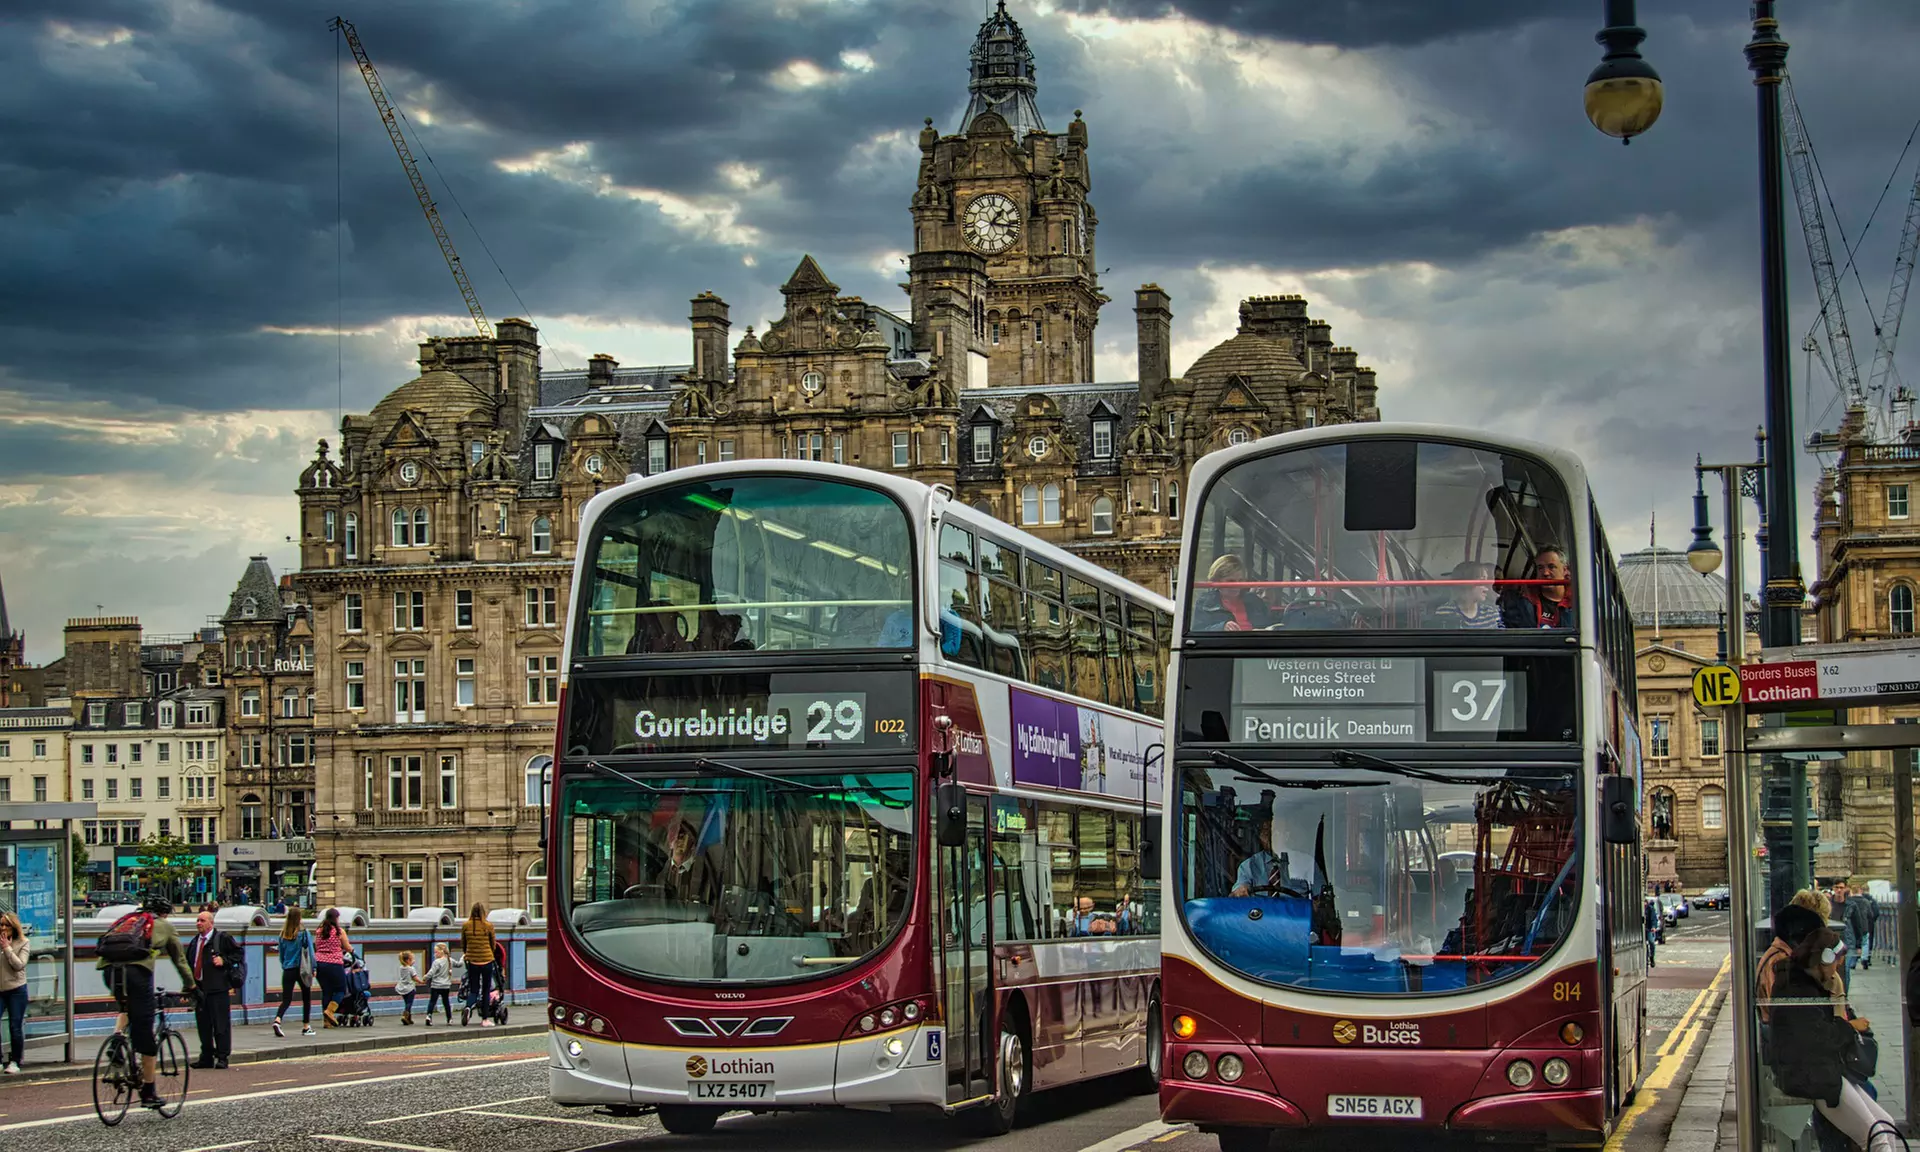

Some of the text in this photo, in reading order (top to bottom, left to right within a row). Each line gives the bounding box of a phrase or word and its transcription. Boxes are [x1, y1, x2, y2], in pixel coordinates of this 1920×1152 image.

[275, 659, 314, 671] ROYAL
[1266, 659, 1320, 670] Western
[1323, 658, 1377, 670] General
[1282, 672, 1376, 684] Princes Street
[1741, 666, 1816, 681] Borders Buses
[1292, 685, 1365, 700] Newington
[1701, 672, 1733, 702] NE
[1748, 685, 1812, 702] Lothian
[1828, 687, 1836, 695] 31
[1863, 685, 1876, 693] X37
[1877, 684, 1888, 692] N7
[1889, 683, 1903, 691] N31
[1451, 679, 1507, 722] 37
[635, 700, 863, 741] Gorebridge 29
[874, 719, 905, 734] 1022
[1244, 716, 1414, 741] Penicuik Deanburn
[960, 730, 983, 755] Lothian
[1017, 723, 1029, 759] My
[1028, 725, 1058, 763] Edinburgh
[1553, 982, 1582, 1002] 814
[1390, 1021, 1419, 1031] Lothian
[1363, 1025, 1421, 1044] Buses
[712, 1058, 774, 1074] Lothian
[697, 1083, 767, 1098] LXZ 5407
[1335, 1097, 1415, 1115] SN56 AGX
